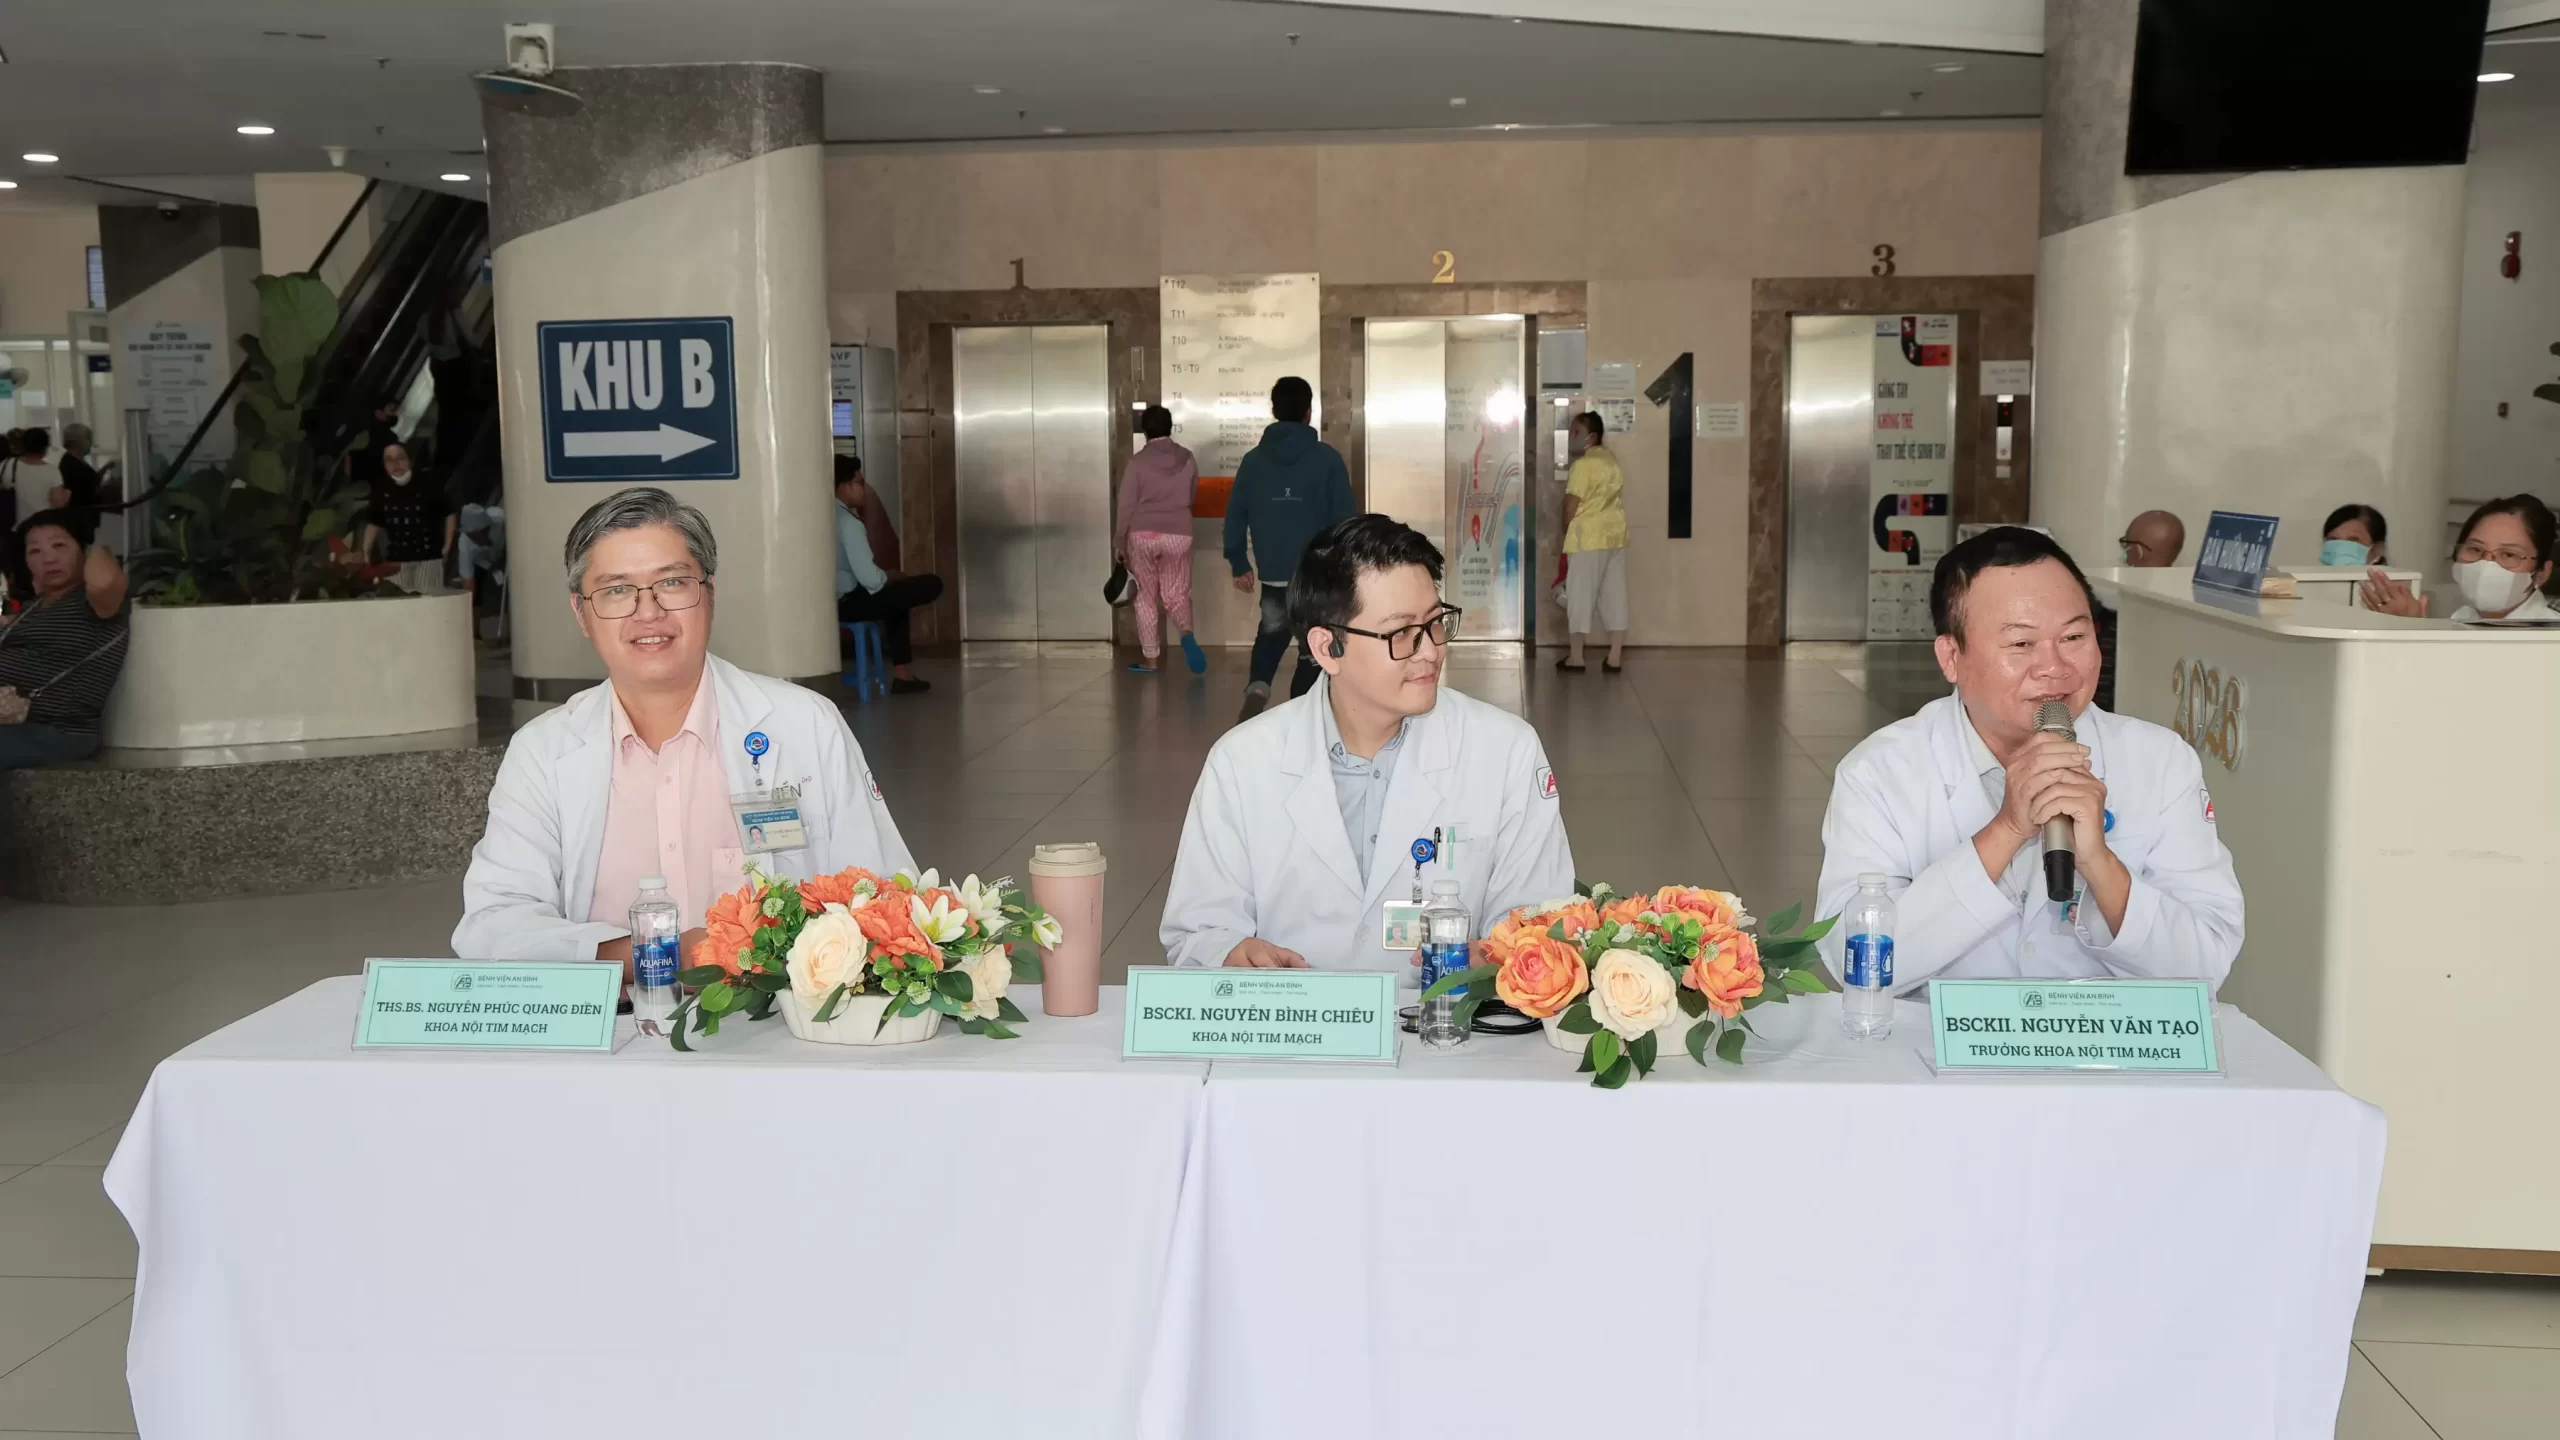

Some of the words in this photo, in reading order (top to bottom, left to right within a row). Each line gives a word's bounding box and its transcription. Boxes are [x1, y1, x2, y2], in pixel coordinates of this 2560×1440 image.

[1432, 250, 1455, 283] 2
[1871, 244, 1895, 277] 3
[1010, 258, 1030, 290] 1
[1171, 280, 1186, 289] T12
[1172, 310, 1185, 318] T11
[1172, 336, 1186, 345] T10
[558, 340, 663, 411] KHU
[680, 338, 715, 408] B
[1172, 364, 1182, 373] T5
[1190, 364, 1200, 373] T9
[1172, 392, 1182, 400] T4
[1172, 424, 1184, 434] T3
[1644, 352, 1693, 538] 1
[2171, 658, 2241, 770] 2026
[640, 957, 674, 969] AQUAFINA
[377, 1002, 424, 1013] THS.BS.
[484, 1001, 520, 1014] PHÚC
[522, 1003, 568, 1015] QUANG
[571, 1001, 602, 1015] ĐIỀN
[1143, 1007, 1196, 1020] BSCKI.
[1200, 1003, 1271, 1022] NGUYỄN
[1275, 1006, 1318, 1022] BÌNH
[1322, 1007, 1374, 1023] CHIÊU
[424, 1022, 458, 1032] KHOA
[461, 1020, 482, 1034] NỘI
[486, 1023, 508, 1033] TIM
[511, 1023, 548, 1035] MẠCH
[1946, 1017, 2016, 1032] BSCKII.
[2021, 1014, 2105, 1033] NGUYỄN
[2109, 1016, 2152, 1034] VĂN
[2157, 1019, 2199, 1038] TẠO
[1192, 1031, 1228, 1042] KHOA
[1231, 1030, 1254, 1045] NỘI
[1256, 1032, 1282, 1043] TIM
[1284, 1033, 1322, 1046] MẠCH
[1969, 1042, 2031, 1057] TRƯỞNG
[2034, 1045, 2075, 1057] KHOA
[2077, 1044, 2104, 1060] NỘI
[2107, 1046, 2134, 1058] TIM
[2138, 1047, 2181, 1061] MẠCH
